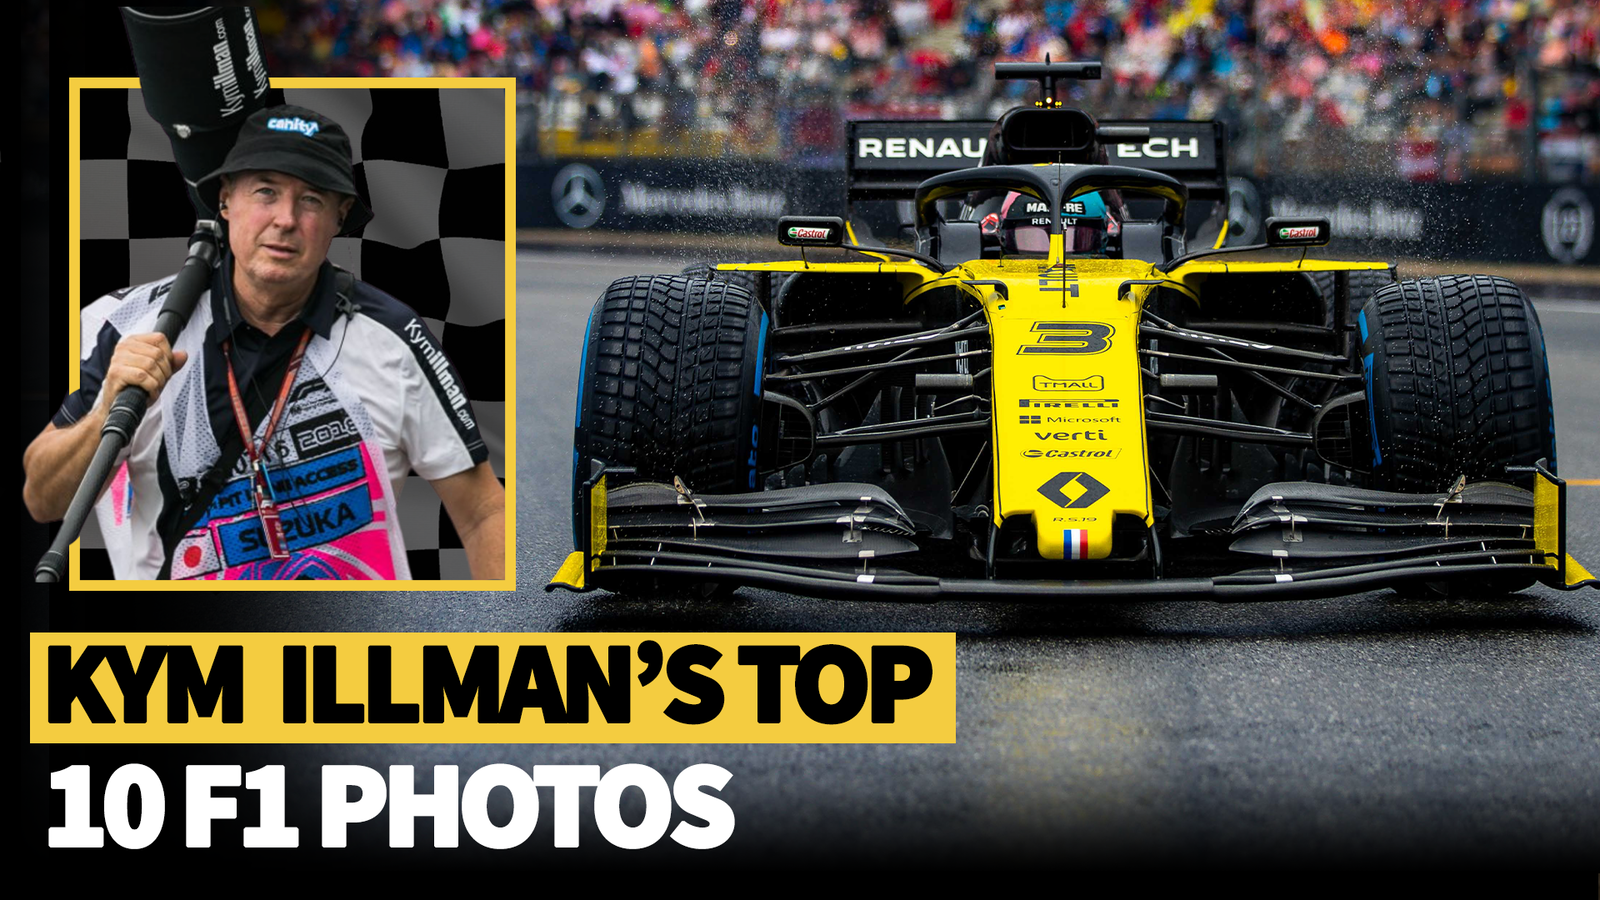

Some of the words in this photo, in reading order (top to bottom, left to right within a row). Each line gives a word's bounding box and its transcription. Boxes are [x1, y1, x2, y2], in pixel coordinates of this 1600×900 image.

[213, 17, 245, 117] Kymillman.com
[858, 137, 989, 159] RENAU
[797, 228, 826, 239] Castrol
[1289, 227, 1317, 238] Castrol
[1016, 321, 1116, 356] 3
[404, 318, 475, 430] Kymillman.com
[1038, 381, 1099, 389] TMALL
[1019, 399, 1119, 408] PIRELLI
[1046, 415, 1122, 424] Microsoft
[1034, 429, 1108, 441] verti
[1045, 449, 1113, 458] Castrol
[294, 459, 359, 493] ACCESS
